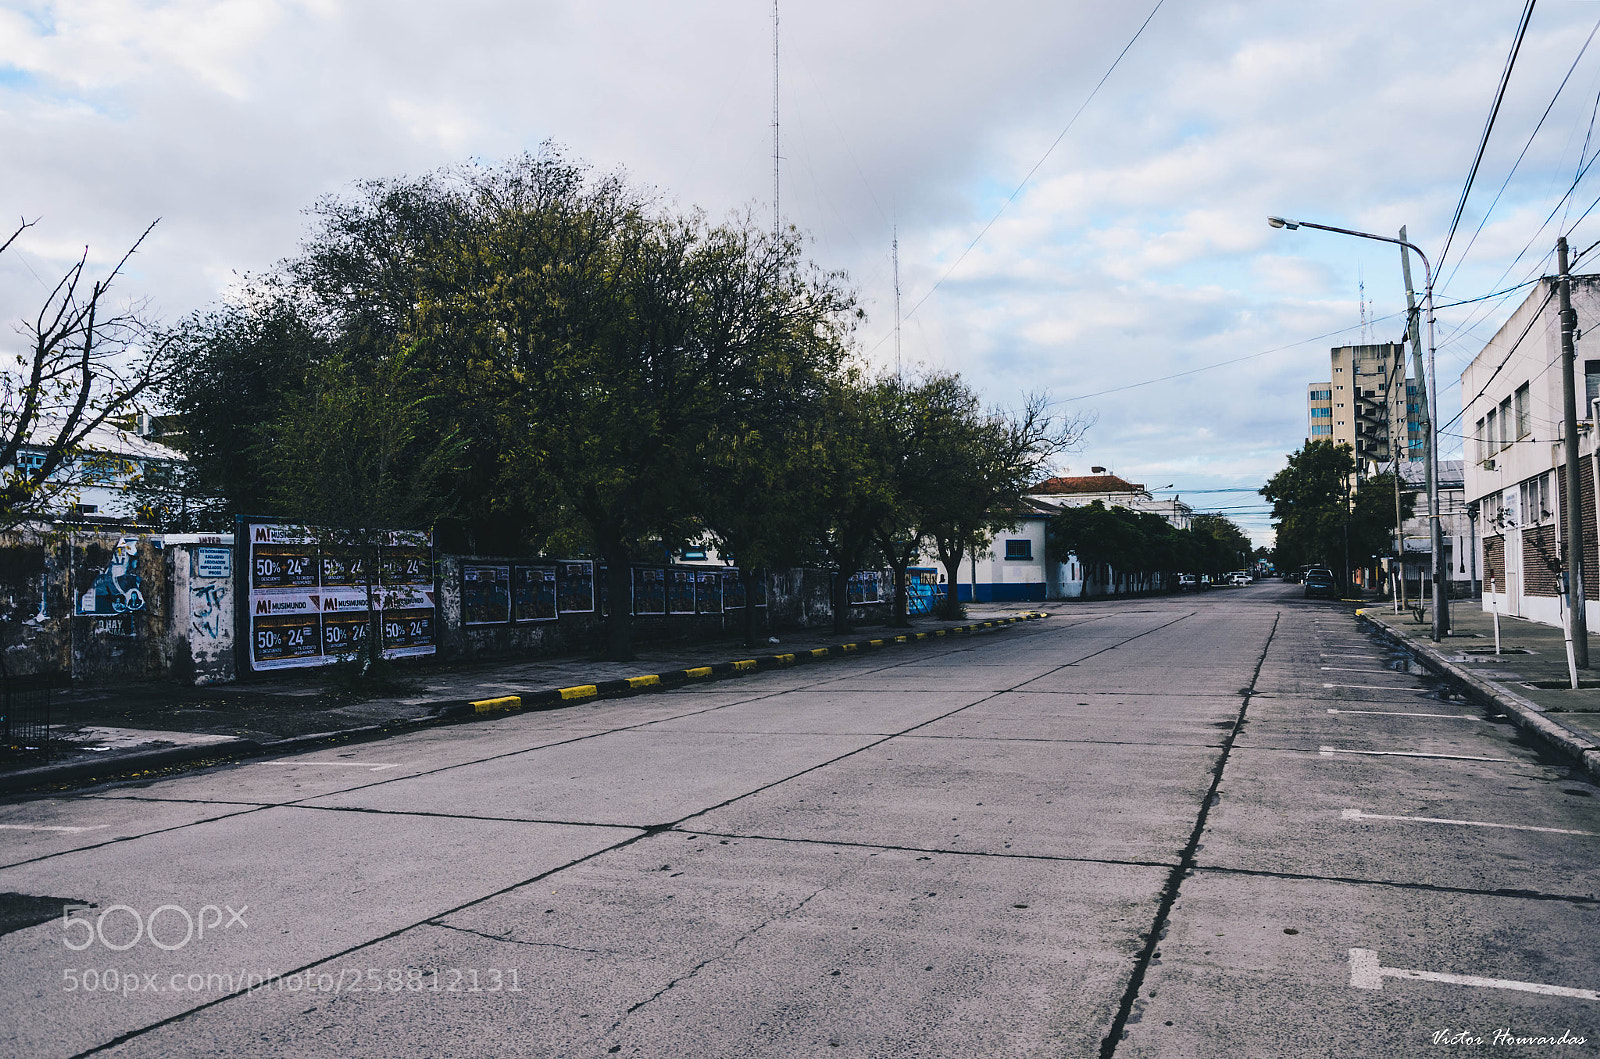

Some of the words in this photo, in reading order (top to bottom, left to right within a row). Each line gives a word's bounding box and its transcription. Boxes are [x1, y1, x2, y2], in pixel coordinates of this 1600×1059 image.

[256, 559, 281, 576] 50%
[287, 559, 302, 575] 24
[407, 559, 419, 574] 24
[255, 599, 272, 615] M!
[272, 601, 307, 610] MUSIMUNDO
[324, 597, 338, 611] M!
[106, 619, 123, 629] HAY
[385, 622, 406, 638] 50%
[410, 621, 422, 636] 24
[257, 630, 282, 649] 50%
[288, 629, 304, 646] 24
[326, 626, 348, 643] 50%
